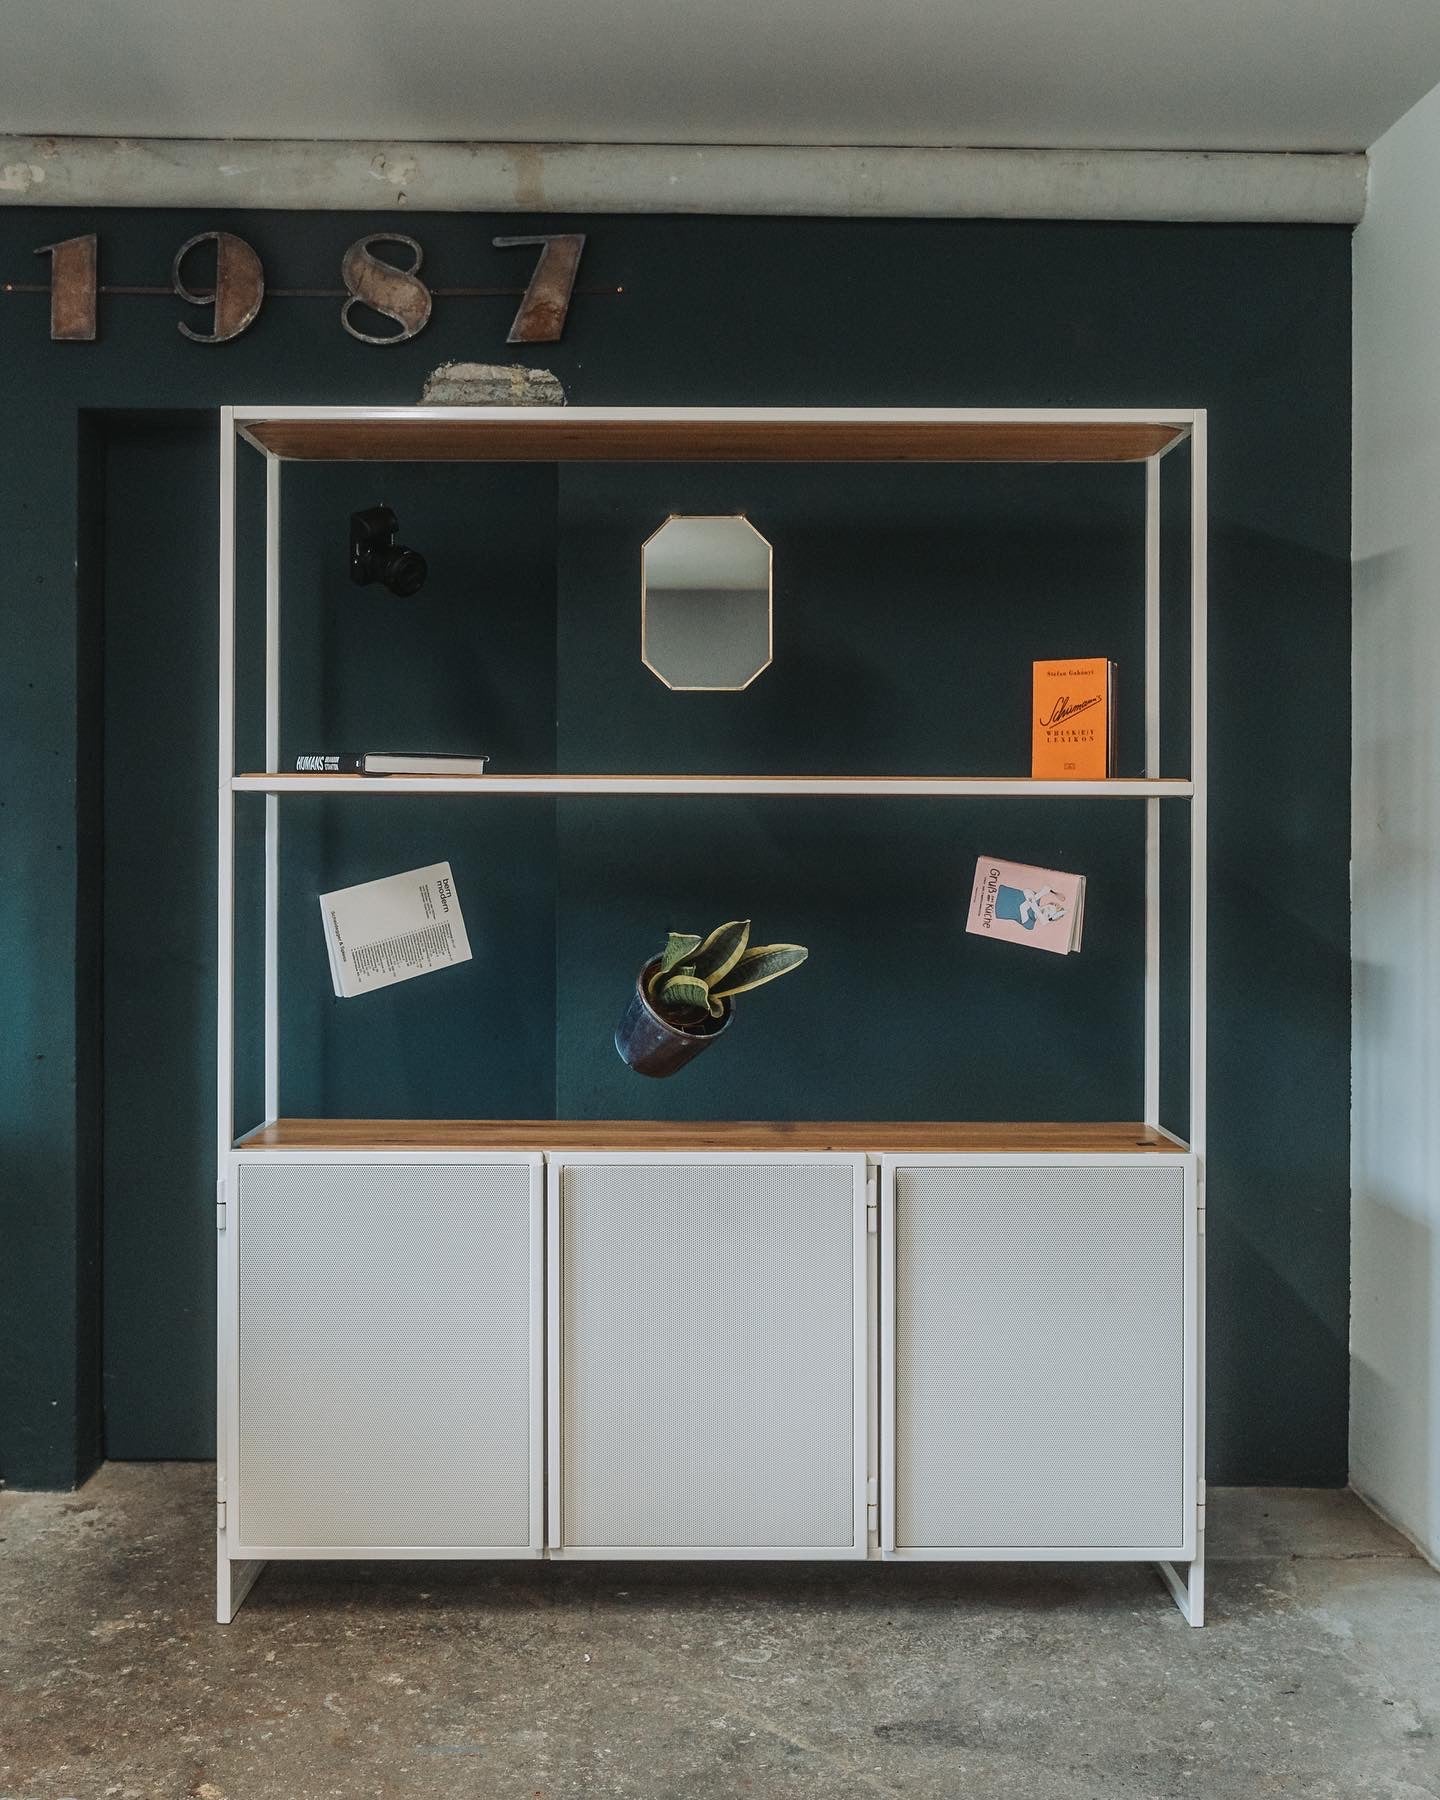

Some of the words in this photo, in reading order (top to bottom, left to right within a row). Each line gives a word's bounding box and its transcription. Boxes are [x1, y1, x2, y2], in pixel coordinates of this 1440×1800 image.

[34, 231, 586, 345] 1987
[296, 756, 325, 771] HUMANS
[988, 868, 1001, 893] Gruß
